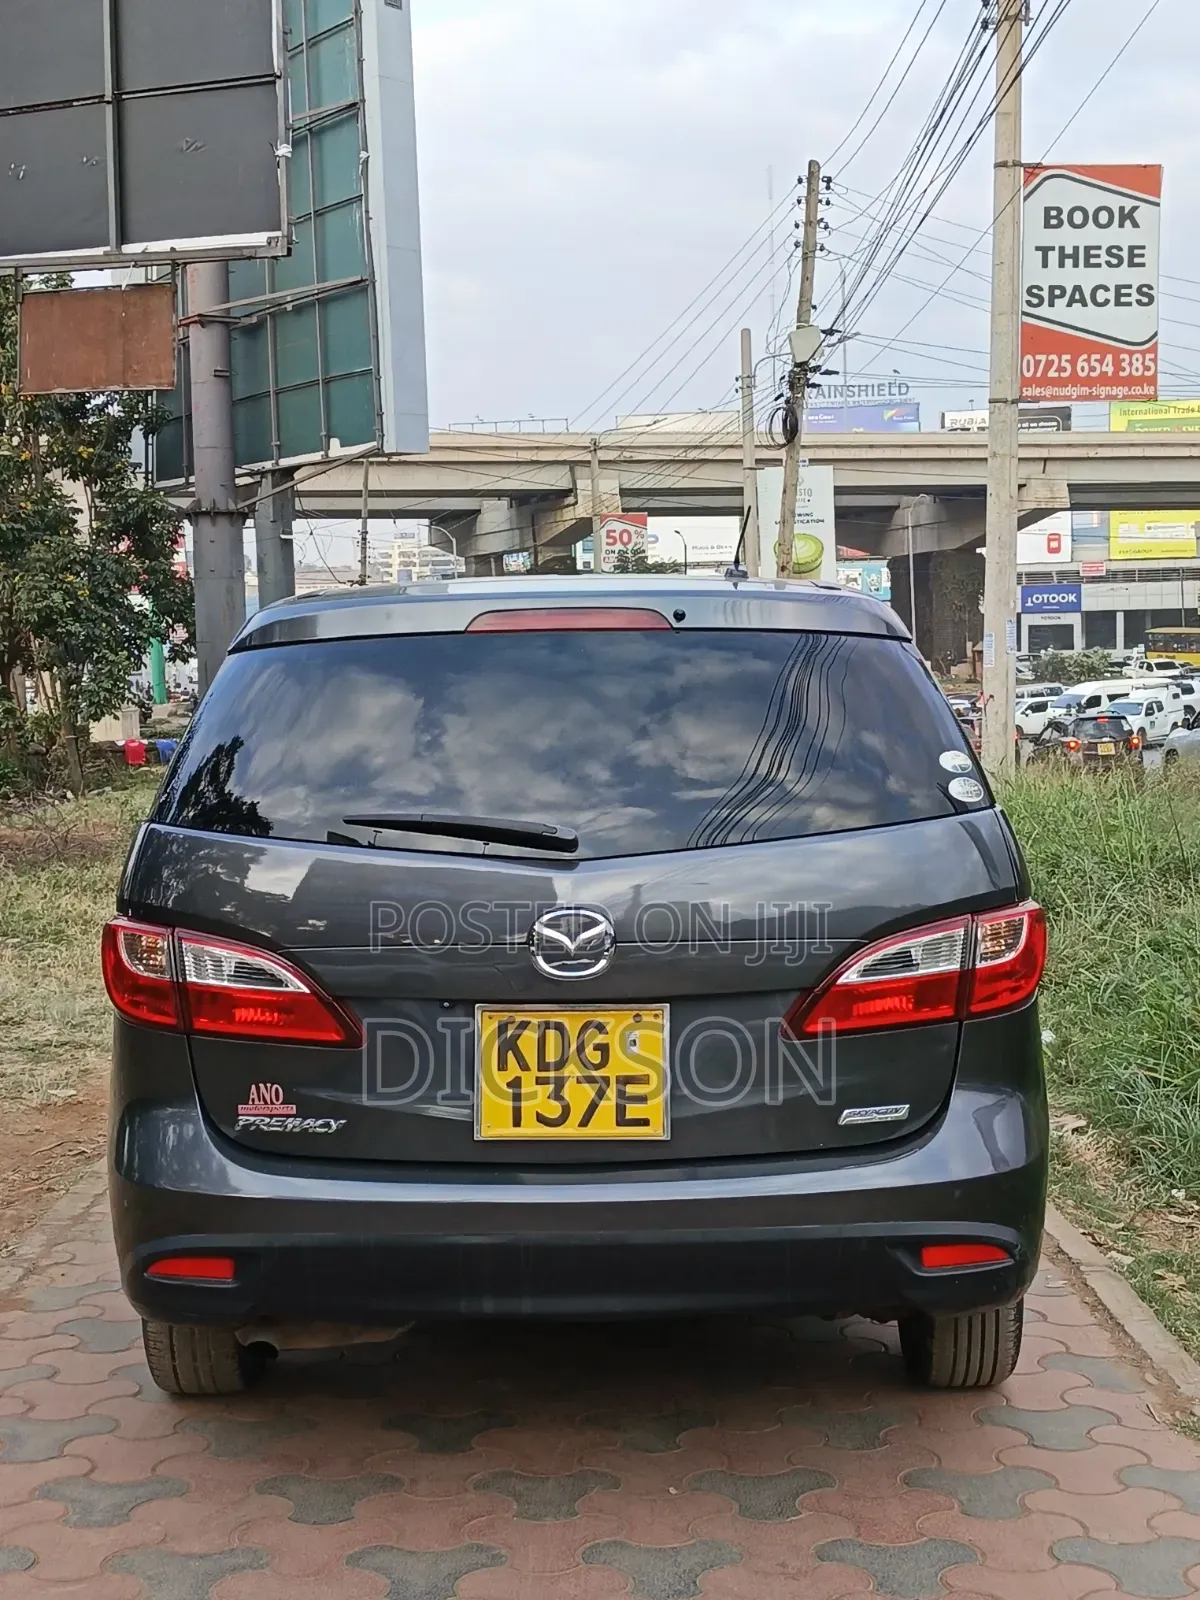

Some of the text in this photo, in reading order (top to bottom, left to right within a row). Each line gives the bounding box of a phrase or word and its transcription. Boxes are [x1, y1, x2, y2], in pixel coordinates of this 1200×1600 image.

[1043, 205, 1141, 230] BOOK
[1034, 244, 1146, 269] THESE
[1025, 283, 1155, 309] SPACES
[1022, 353, 1156, 378] 0725 654 385
[1022, 383, 1155, 399] sales@nudgim-signage.co.ke
[1119, 406, 1171, 416] International
[1173, 405, 1195, 415] Trade
[496, 1018, 611, 1073] KDG
[248, 1083, 284, 1105] ANO
[504, 1074, 652, 1128] 137E
[234, 1115, 347, 1134] PREMACY
